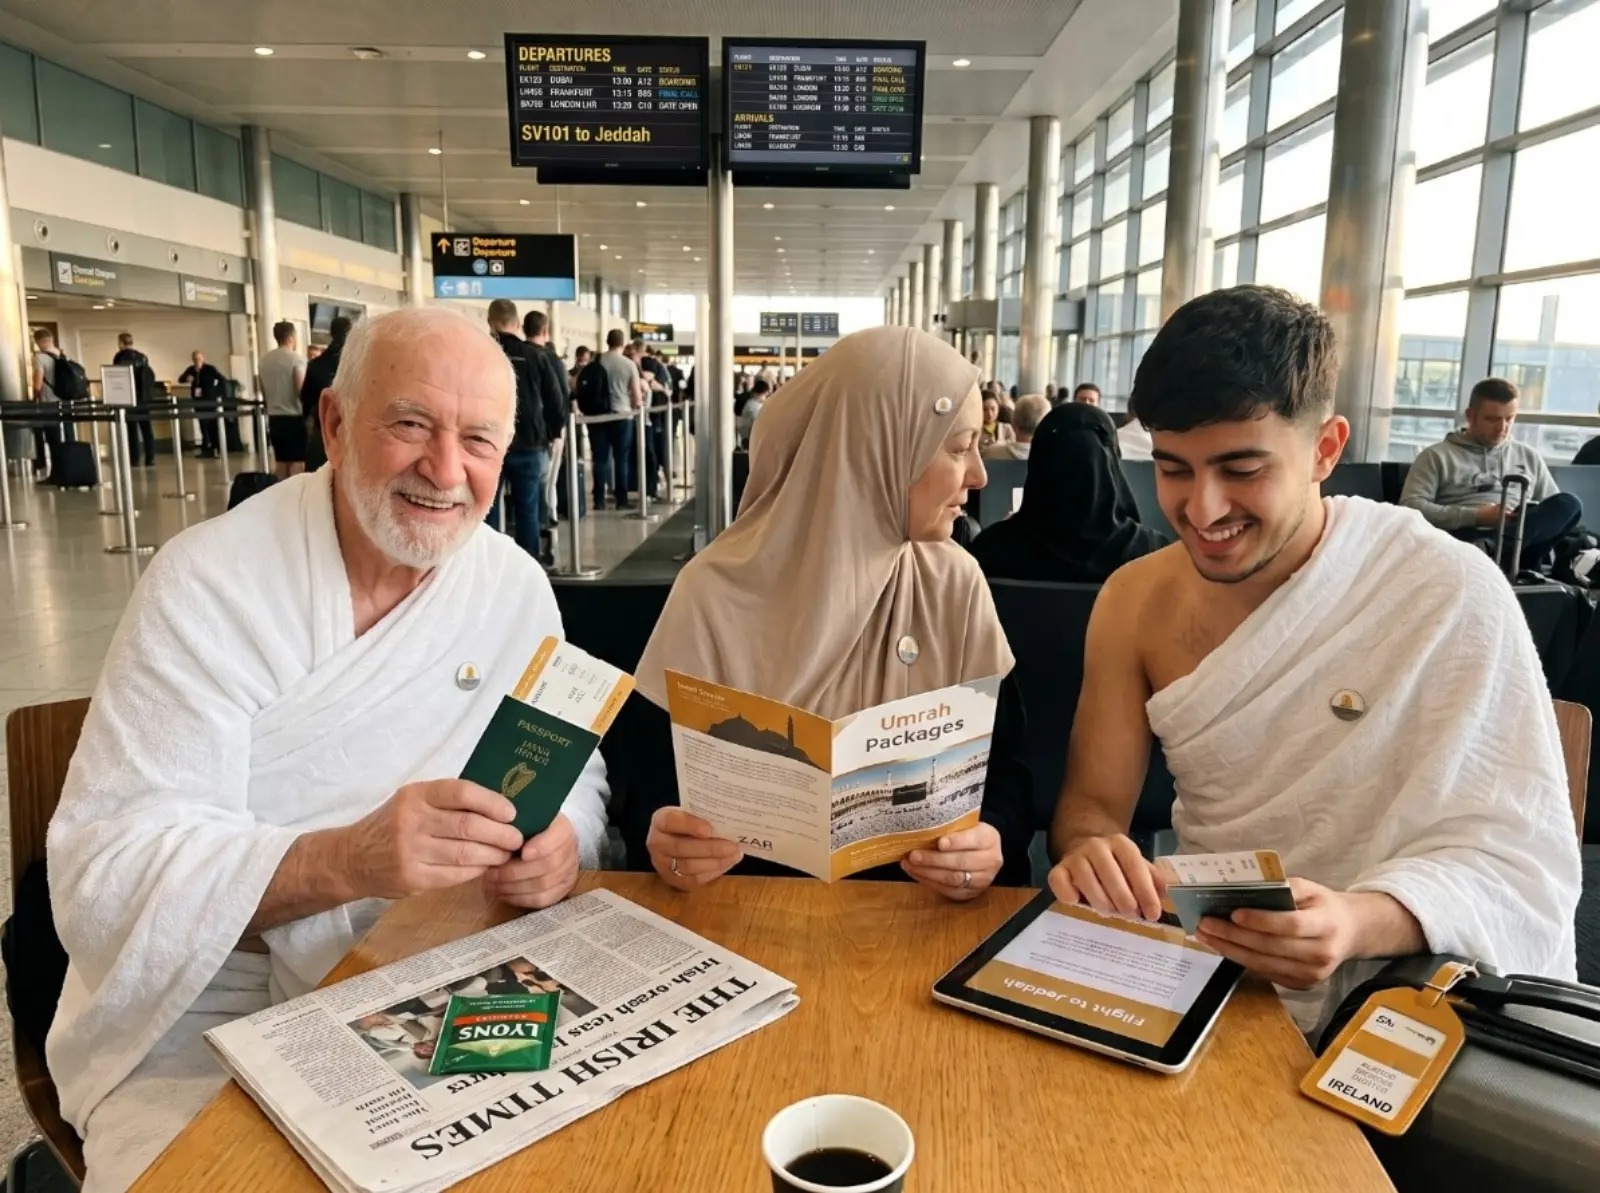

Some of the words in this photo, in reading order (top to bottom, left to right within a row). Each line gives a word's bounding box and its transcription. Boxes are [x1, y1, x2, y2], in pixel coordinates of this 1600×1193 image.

[519, 46, 611, 62] DEPARTURES
[550, 76, 573, 84] DUBAI
[612, 77, 632, 85] 13:00
[637, 77, 652, 86] A12
[550, 88, 593, 96] FRANKFURT
[612, 89, 632, 97] 13:15
[550, 100, 580, 108] LONDON
[612, 101, 632, 109] 13:20
[638, 101, 652, 110] C10
[734, 113, 774, 123] ARRIVALS
[521, 124, 570, 141] SV101
[575, 127, 590, 141] to
[595, 126, 651, 142] Jeddah
[880, 703, 951, 730] Umrah
[517, 719, 573, 748] PASSPORT
[866, 719, 964, 752] Packages
[737, 835, 773, 850] ZAR
[671, 957, 722, 985] Irish
[672, 976, 758, 1023] THE
[1004, 977, 1068, 1001] Jeddah
[1070, 997, 1088, 1009] to
[1092, 1004, 1145, 1026] Flight
[458, 1023, 539, 1040] LYONS
[559, 1019, 679, 1086] IRISH
[1328, 1078, 1393, 1114] IRELAND
[410, 1081, 564, 1160] TIMES
